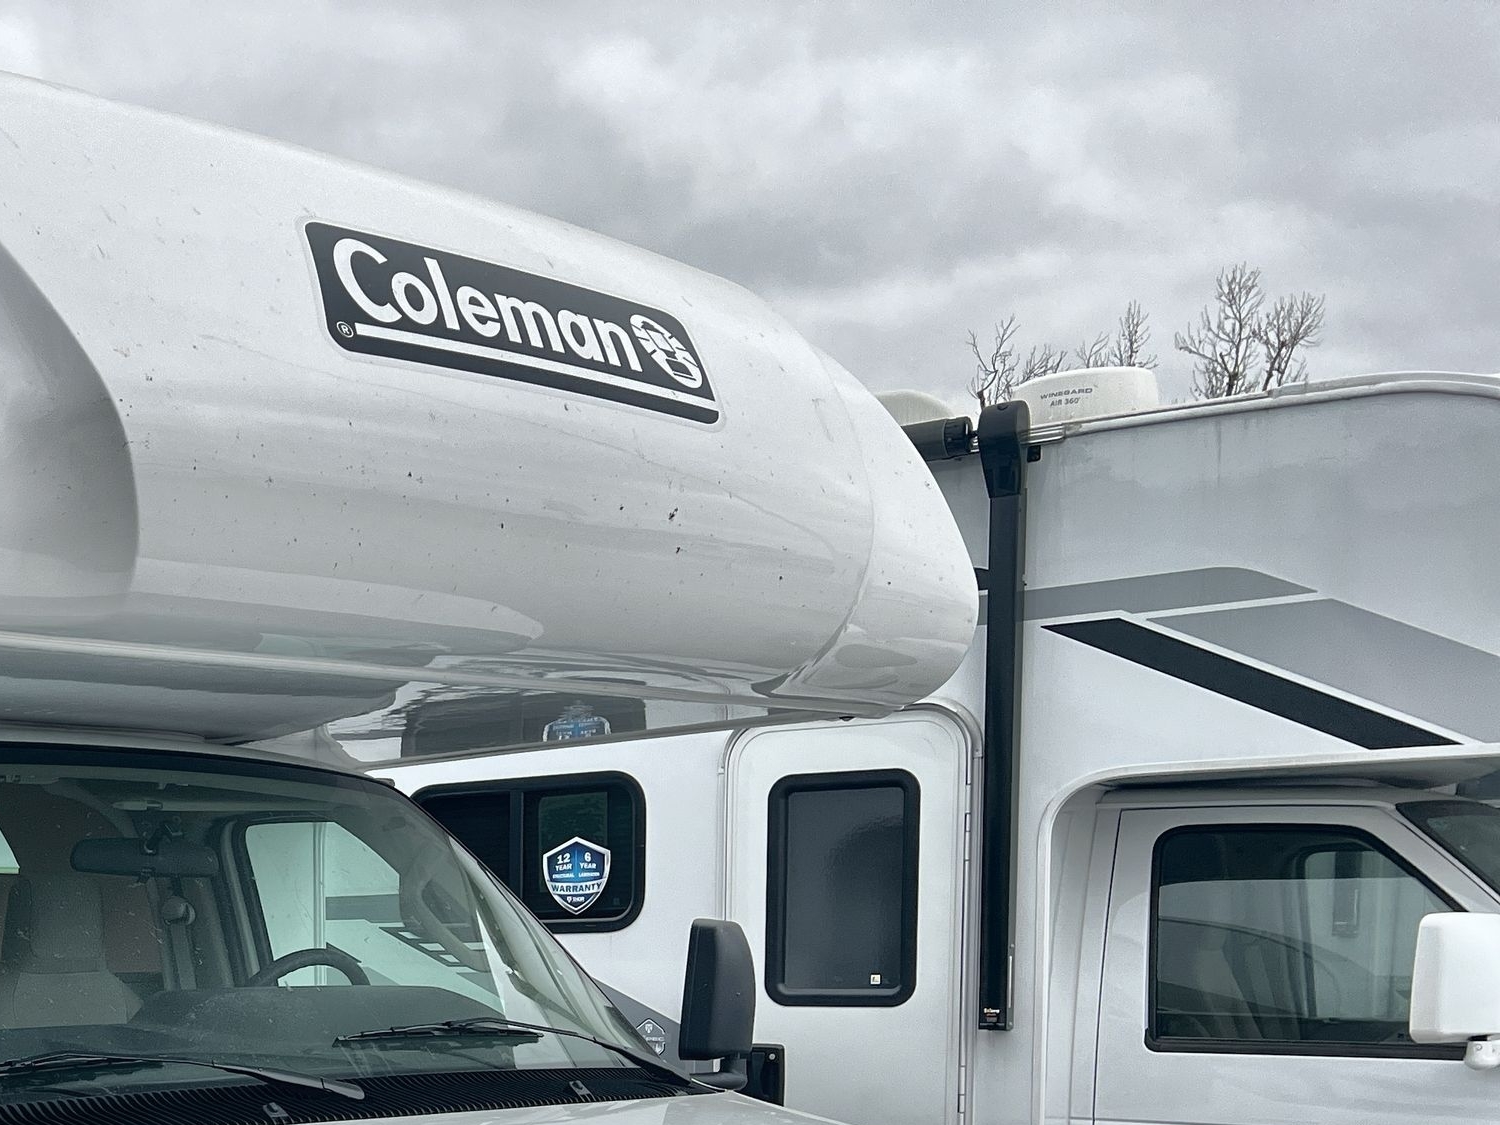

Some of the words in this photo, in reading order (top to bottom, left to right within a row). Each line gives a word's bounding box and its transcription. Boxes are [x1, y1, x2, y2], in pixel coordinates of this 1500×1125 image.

[333, 238, 644, 373] Coleman
[1040, 388, 1093, 399] WINEGARD
[1050, 399, 1062, 407] AIR
[557, 852, 571, 865] 12
[584, 852, 592, 862] 6
[555, 863, 573, 871] YEAR
[551, 882, 603, 893] WARRANTY
